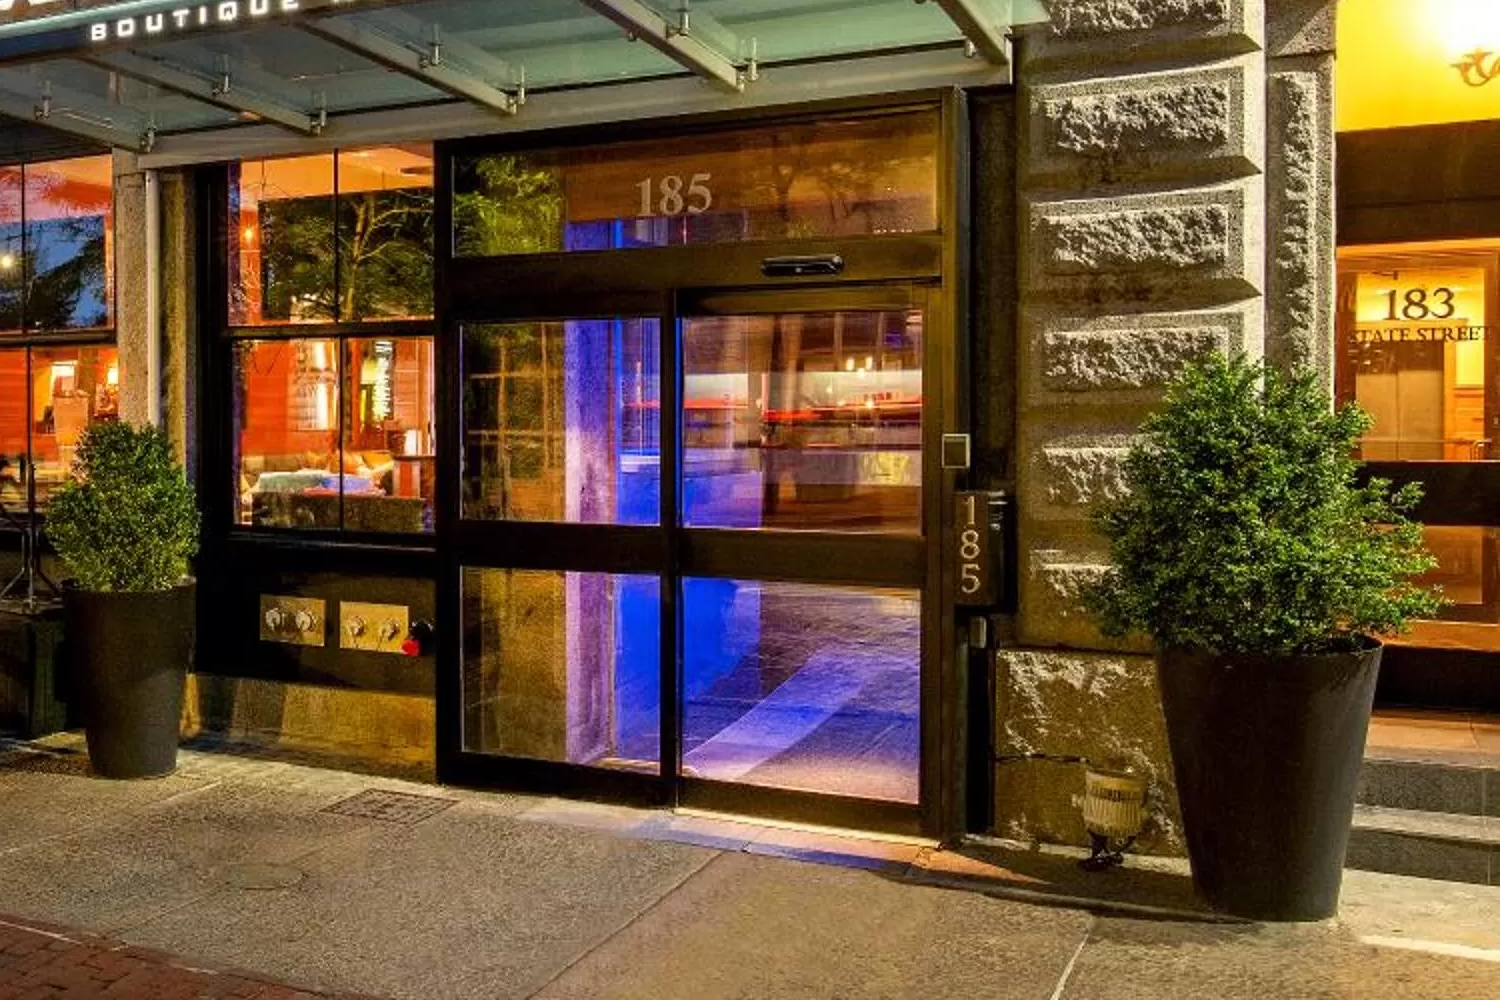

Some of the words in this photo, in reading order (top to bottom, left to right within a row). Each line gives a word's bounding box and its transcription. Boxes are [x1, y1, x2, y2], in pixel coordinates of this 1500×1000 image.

[636, 172, 712, 216] 185
[1382, 287, 1455, 321] 183
[1349, 327, 1411, 342] STATE
[1416, 325, 1493, 341] STREET
[961, 495, 980, 594] 185
